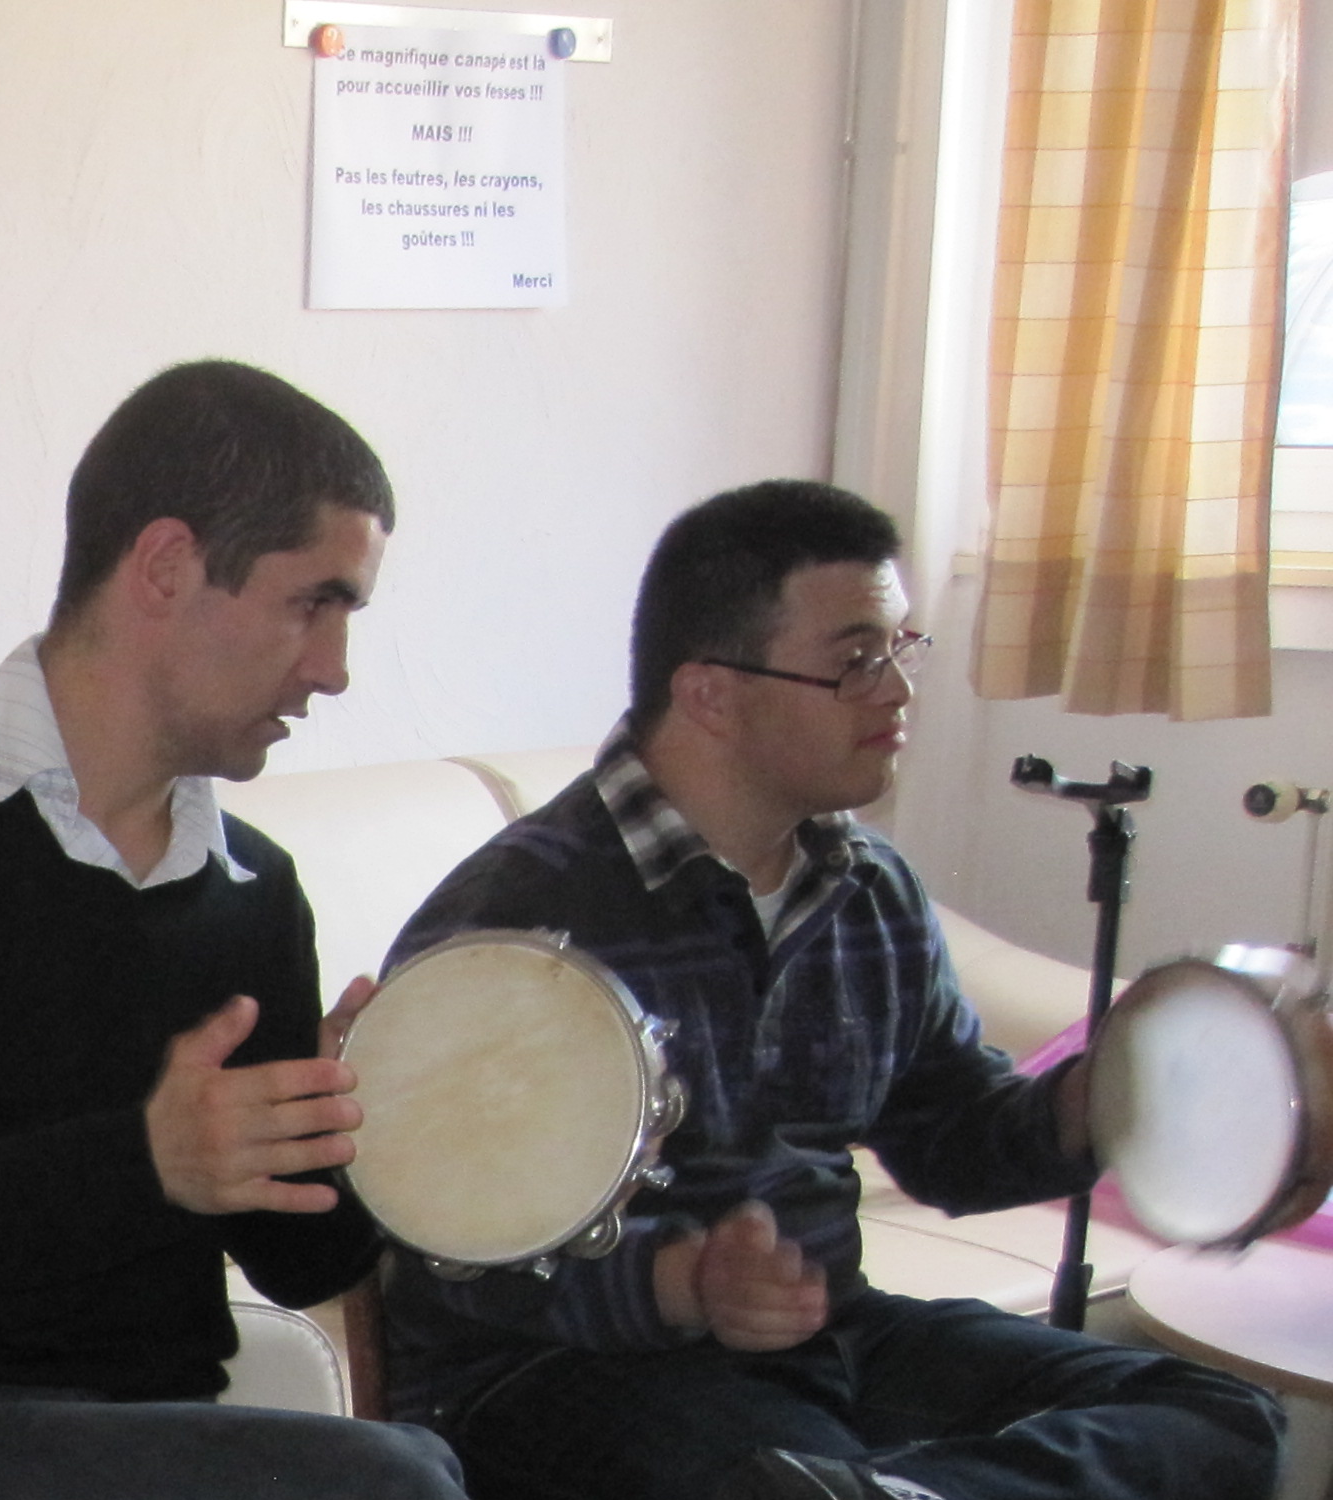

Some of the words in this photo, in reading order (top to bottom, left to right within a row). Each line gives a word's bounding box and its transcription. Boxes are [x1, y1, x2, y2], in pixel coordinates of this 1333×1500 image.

[361, 48, 449, 68] magnifique
[454, 52, 505, 71] canapé
[509, 56, 529, 70] est
[532, 55, 545, 71] là
[337, 79, 370, 95] pour
[375, 80, 449, 97] accueillir
[455, 84, 481, 98] vos
[485, 83, 525, 100] fesses
[530, 85, 544, 101] !!!
[412, 124, 453, 141] MAIS
[458, 126, 473, 142] !!!
[335, 167, 361, 184] Pas
[366, 168, 387, 185] les
[391, 168, 448, 189] feutres,
[453, 170, 475, 188] les
[480, 174, 543, 191] crayons,
[361, 199, 382, 216] les
[388, 200, 469, 217] chaussures
[474, 202, 487, 217] ni
[493, 202, 515, 218] les
[402, 231, 457, 250] goûters
[461, 231, 475, 247] !!!
[513, 273, 552, 288] Merci
